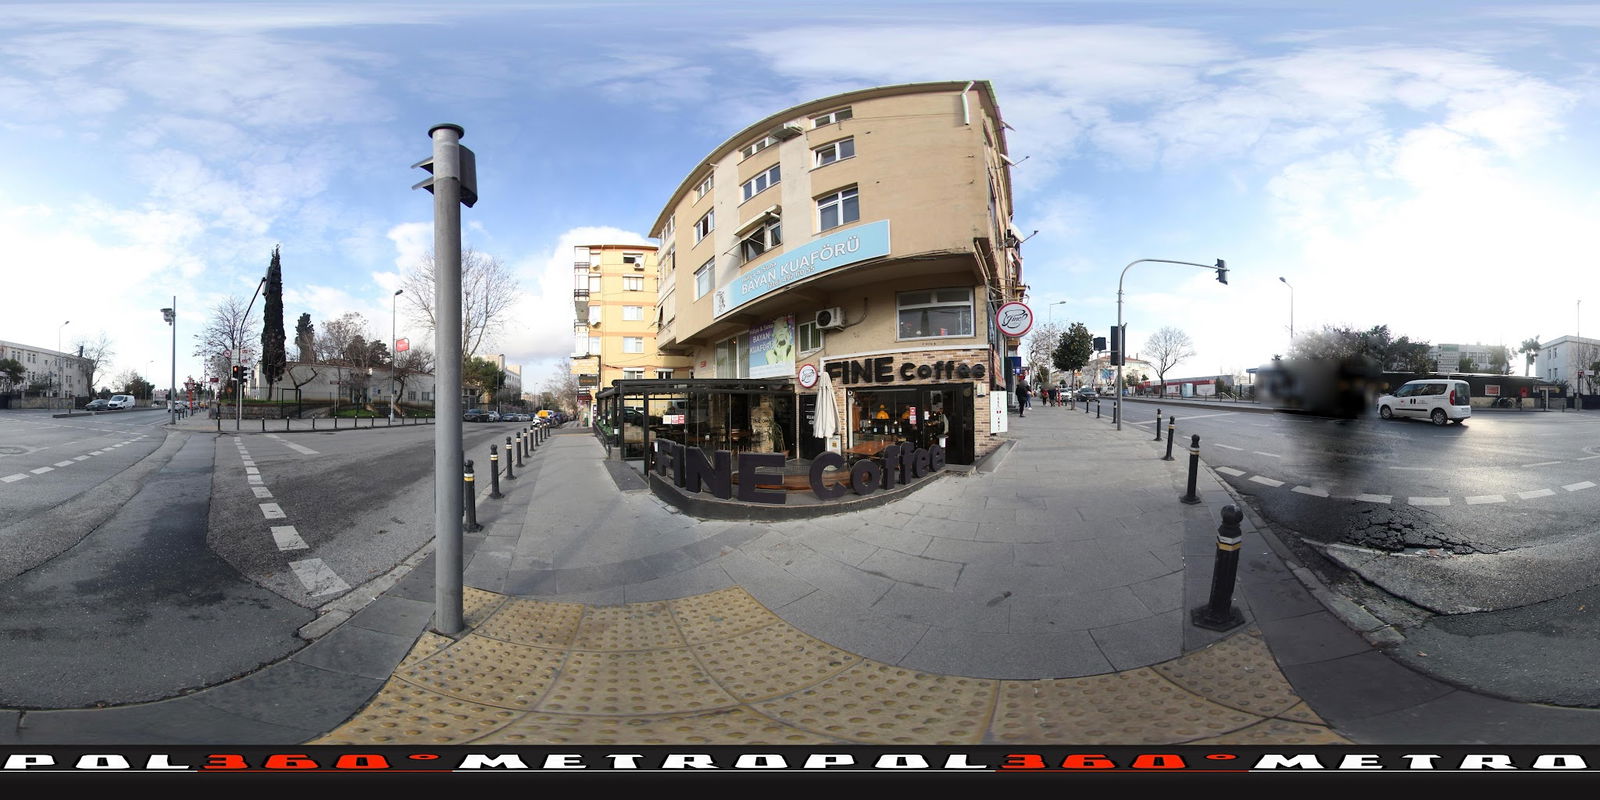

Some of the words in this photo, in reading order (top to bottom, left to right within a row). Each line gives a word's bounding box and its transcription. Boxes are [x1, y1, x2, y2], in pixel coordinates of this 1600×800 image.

[742, 272, 776, 294] BAYAN
[781, 237, 859, 275] KUAFÖRÜ
[752, 331, 771, 343] BAYAN
[825, 356, 895, 385] FINE
[653, 437, 786, 505] FINE
[809, 441, 946, 502] Coffee
